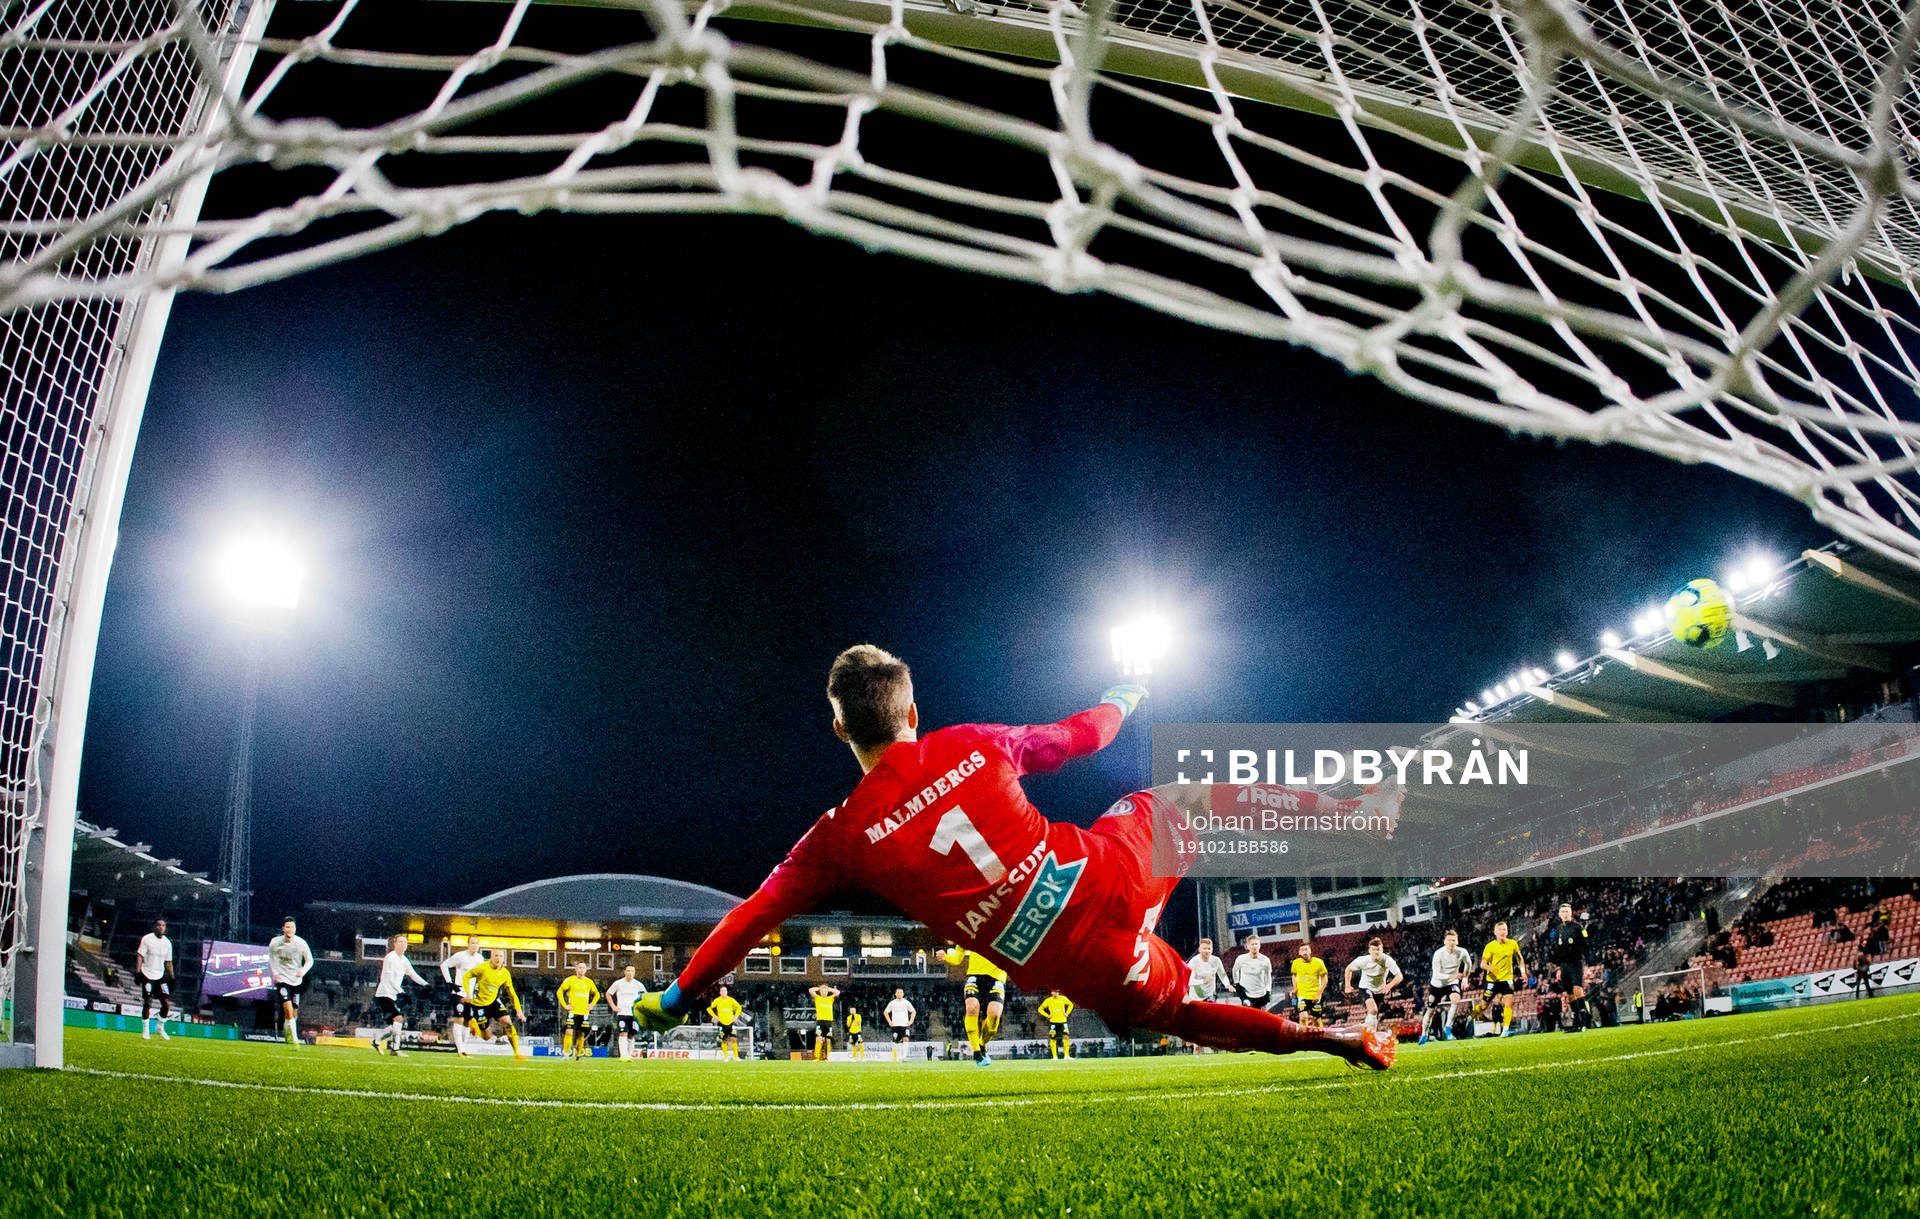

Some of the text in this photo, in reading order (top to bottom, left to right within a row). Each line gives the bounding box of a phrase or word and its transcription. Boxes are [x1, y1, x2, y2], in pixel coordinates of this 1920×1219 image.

[864, 750, 987, 844] MALMBERGS
[1250, 787, 1300, 811] Rätt
[929, 804, 1009, 885] 1
[955, 839, 1048, 939] JANSSON
[1005, 872, 1068, 953] HEROK
[1231, 913, 1250, 926] NA
